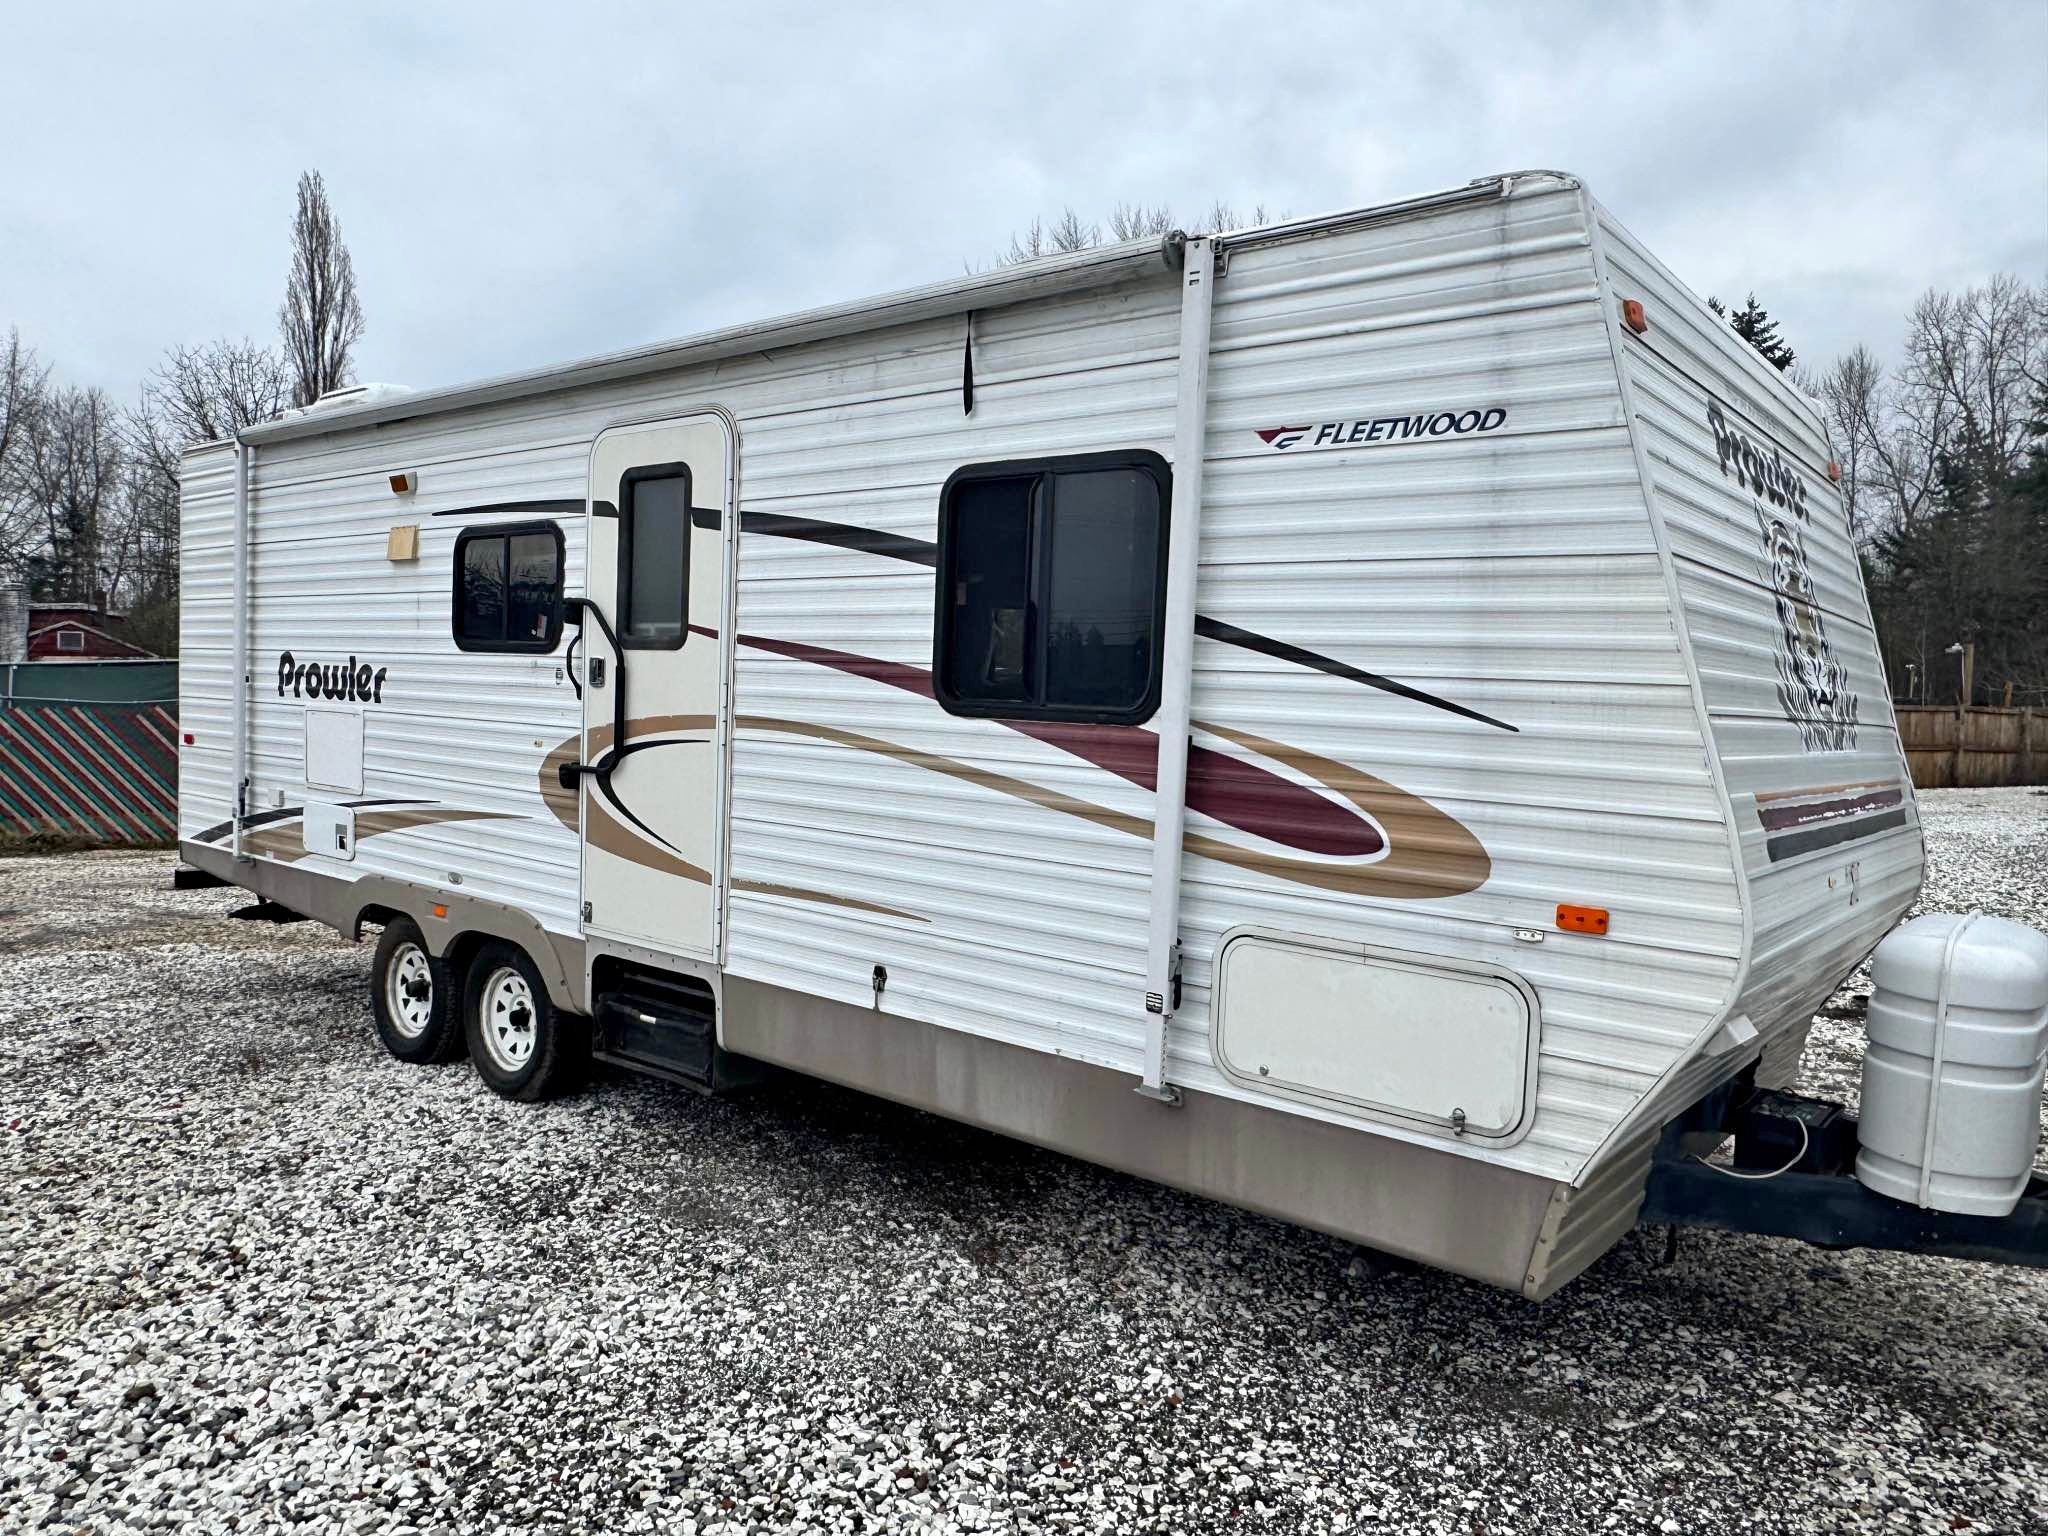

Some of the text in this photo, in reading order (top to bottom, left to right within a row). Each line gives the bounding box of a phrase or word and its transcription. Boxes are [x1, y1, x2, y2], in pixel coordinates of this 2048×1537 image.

[1314, 408, 1506, 445] FLEETWOOD
[1706, 400, 1811, 526] Prowler
[278, 651, 387, 703] Prowler
